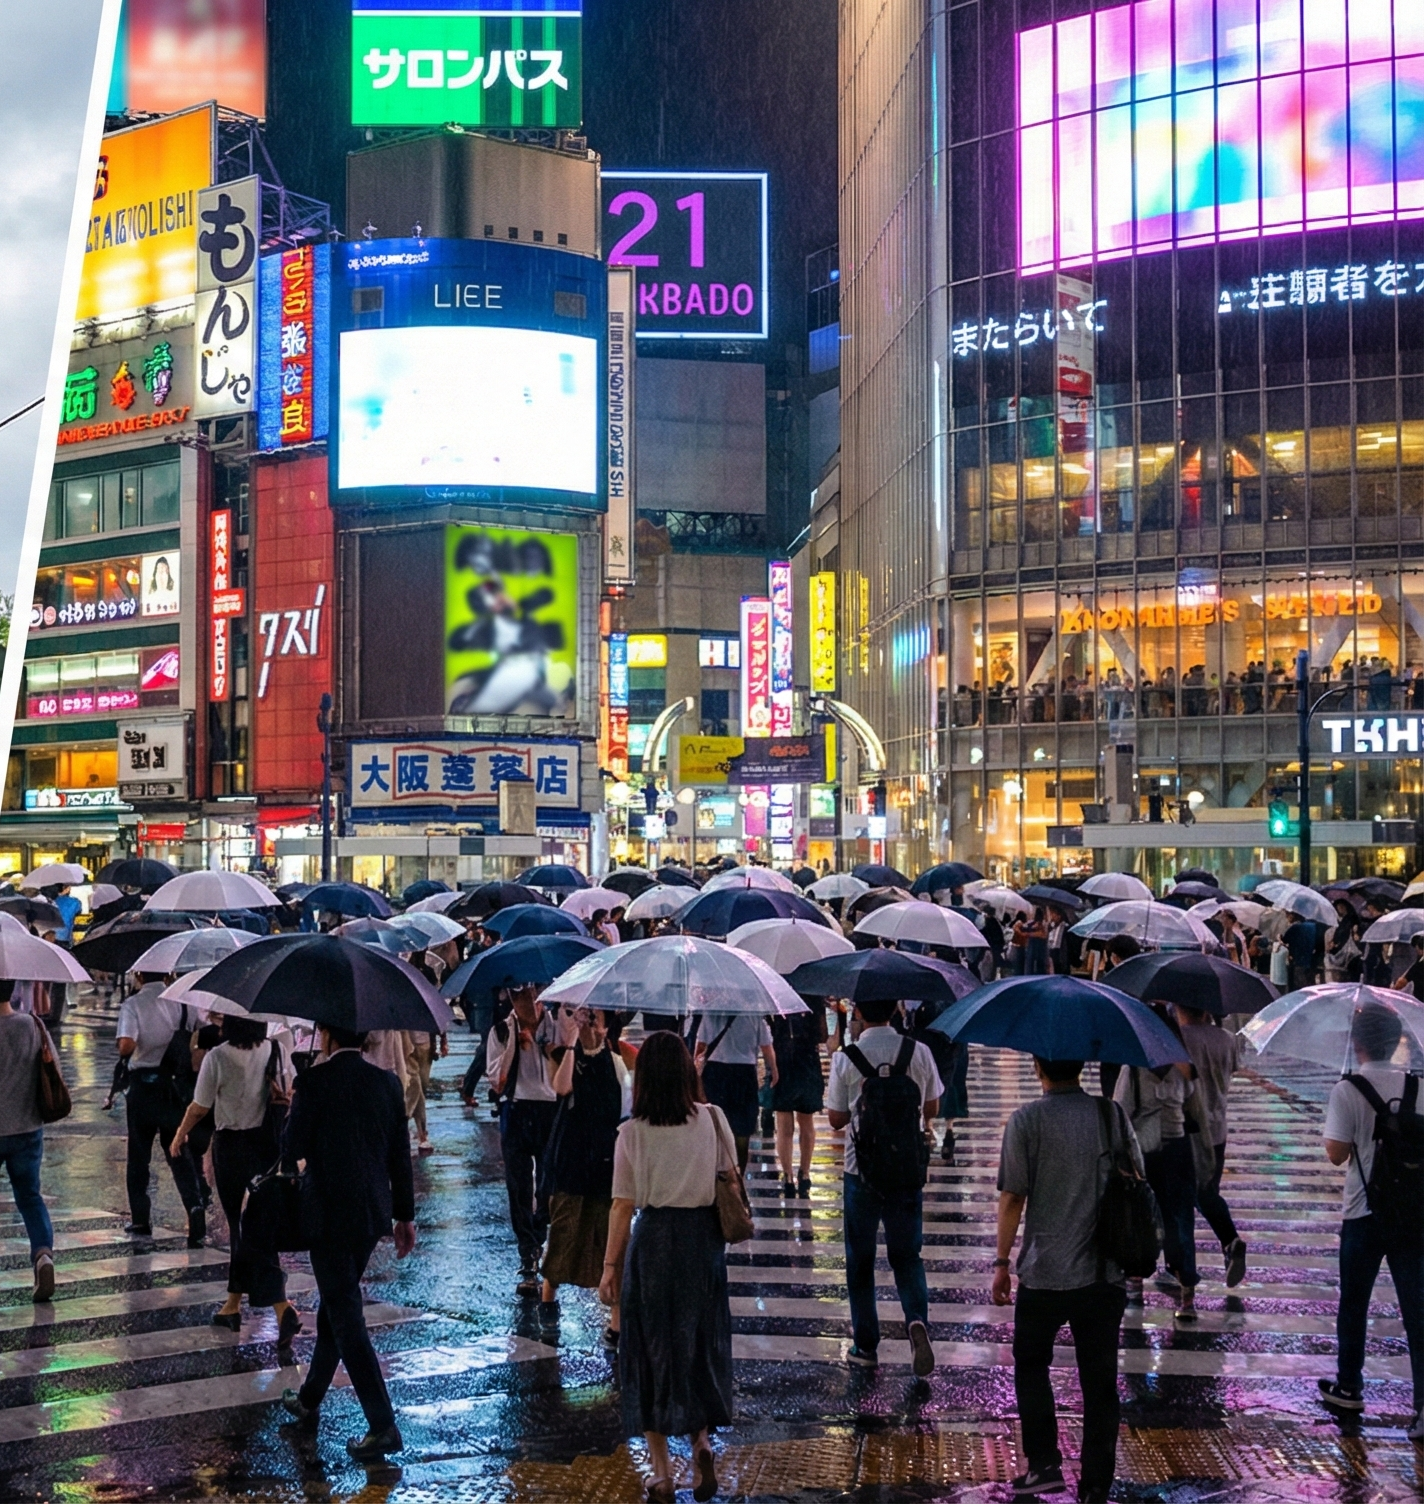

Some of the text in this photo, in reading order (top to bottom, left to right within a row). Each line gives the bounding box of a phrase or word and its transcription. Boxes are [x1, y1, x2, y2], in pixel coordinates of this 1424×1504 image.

[363, 48, 568, 90] サロンパス
[608, 190, 704, 268] 21
[199, 193, 255, 404] もんじゃ
[639, 282, 754, 316] KBADO
